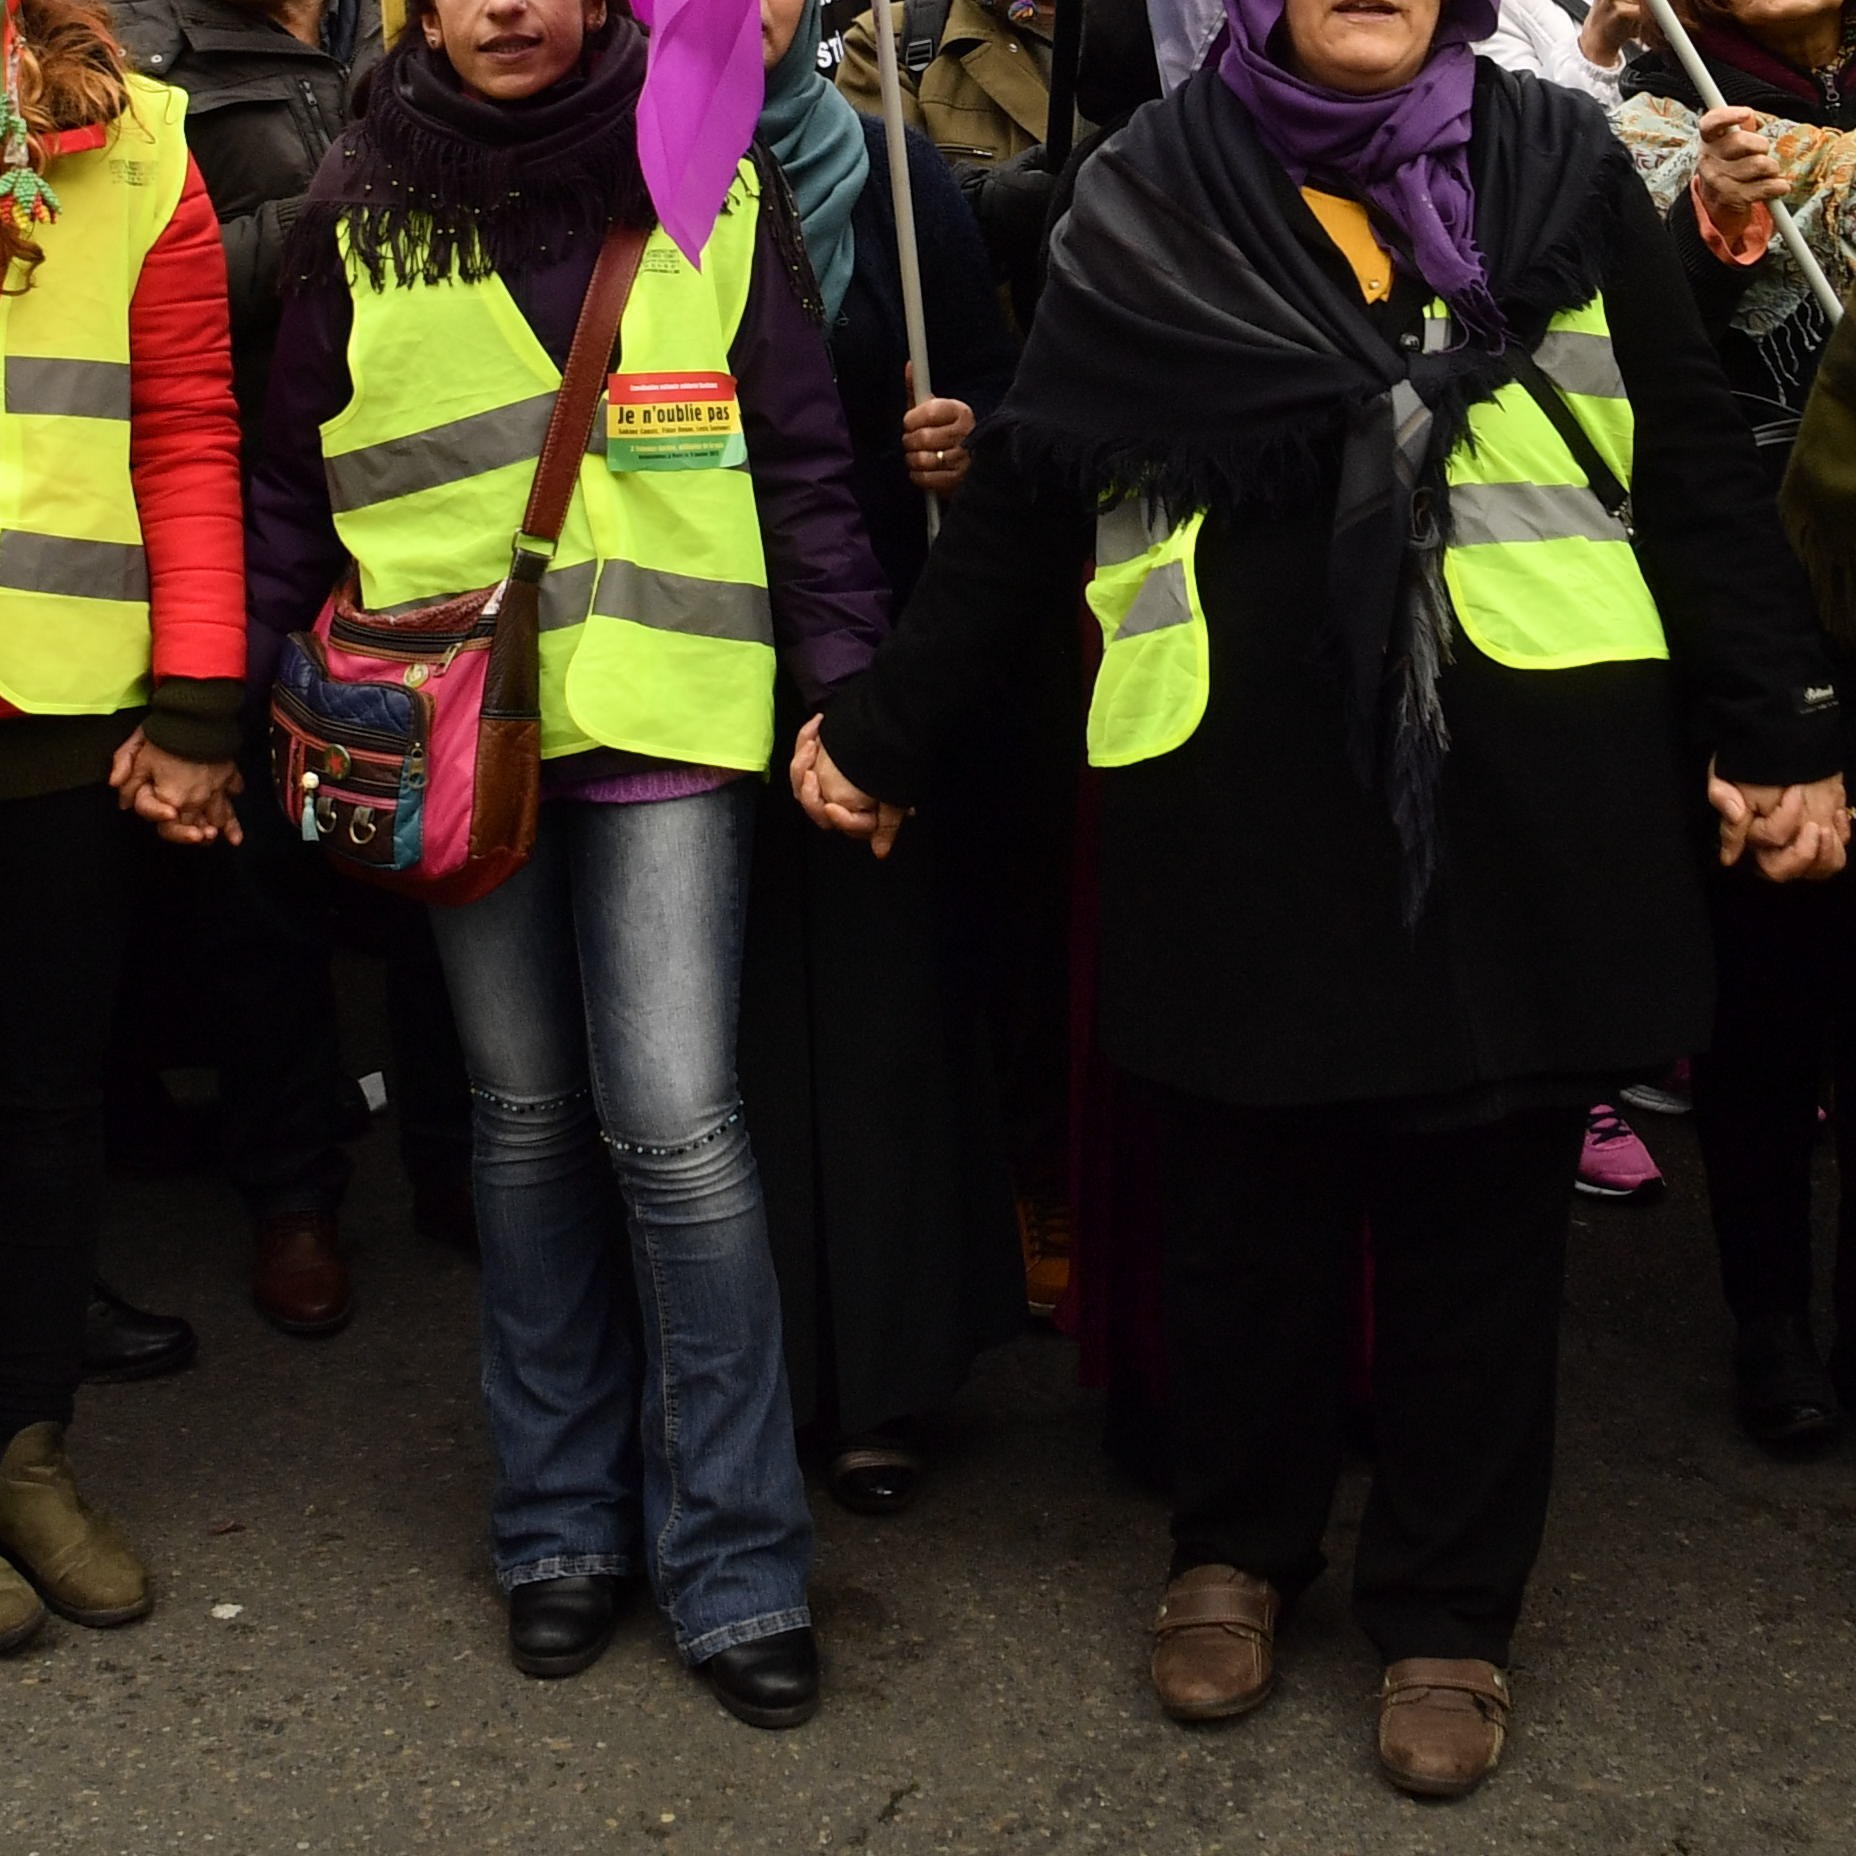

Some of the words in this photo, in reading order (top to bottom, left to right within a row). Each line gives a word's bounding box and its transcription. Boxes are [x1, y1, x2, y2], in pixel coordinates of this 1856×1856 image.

[617, 405, 635, 425] Je
[642, 404, 703, 424] n'oublie
[707, 405, 730, 423] pas
